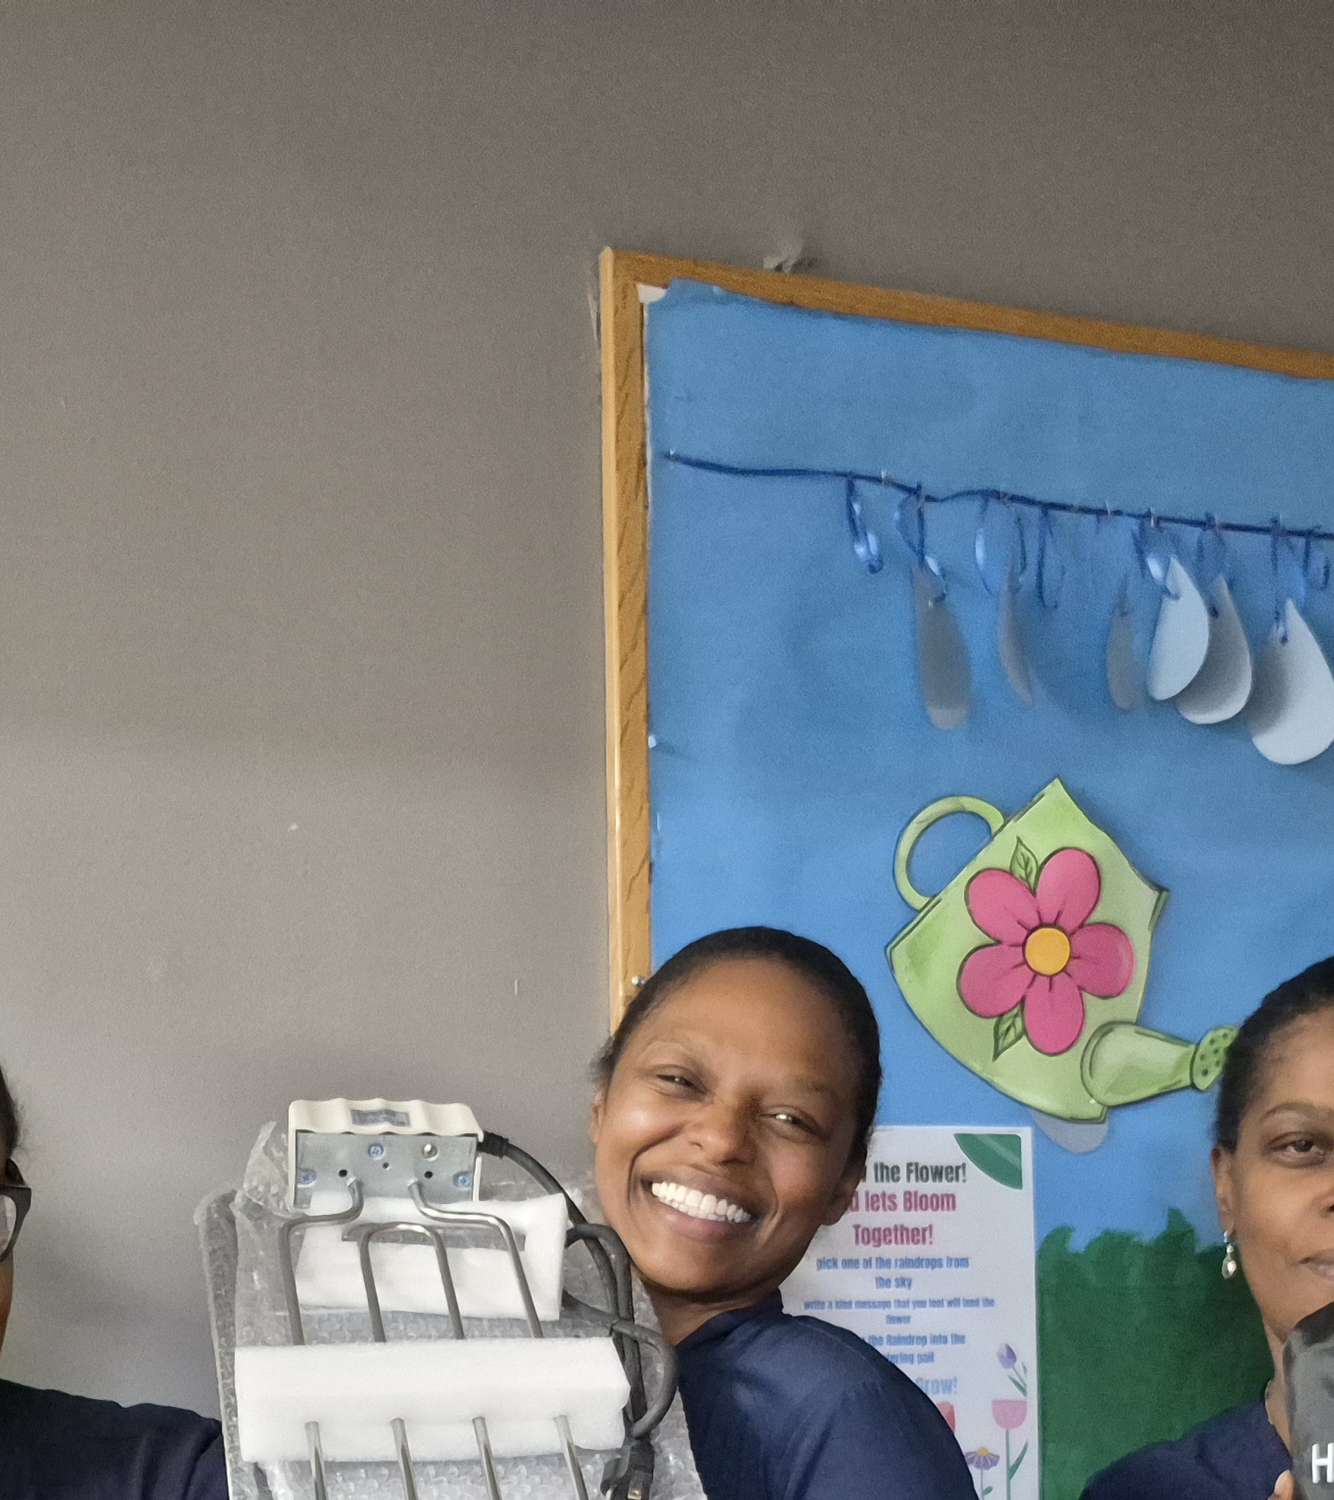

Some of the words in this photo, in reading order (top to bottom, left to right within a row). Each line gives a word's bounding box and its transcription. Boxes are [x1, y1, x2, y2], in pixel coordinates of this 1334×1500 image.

[873, 1162, 901, 1183] the
[906, 1161, 967, 1183] Flower!
[864, 1190, 898, 1212] lets
[903, 1190, 957, 1212] Bloom
[852, 1223, 933, 1248] Together!
[817, 1257, 838, 1271] pick
[841, 1259, 860, 1269] one
[863, 1258, 872, 1269] of
[875, 1257, 892, 1269] the
[894, 1257, 943, 1270] raindrops
[946, 1256, 969, 1268] from
[875, 1276, 891, 1289] the
[894, 1276, 913, 1290] sky
[868, 1334, 883, 1346] the
[886, 1334, 927, 1347] Raindrop
[930, 1334, 948, 1345] into
[951, 1333, 966, 1344] the
